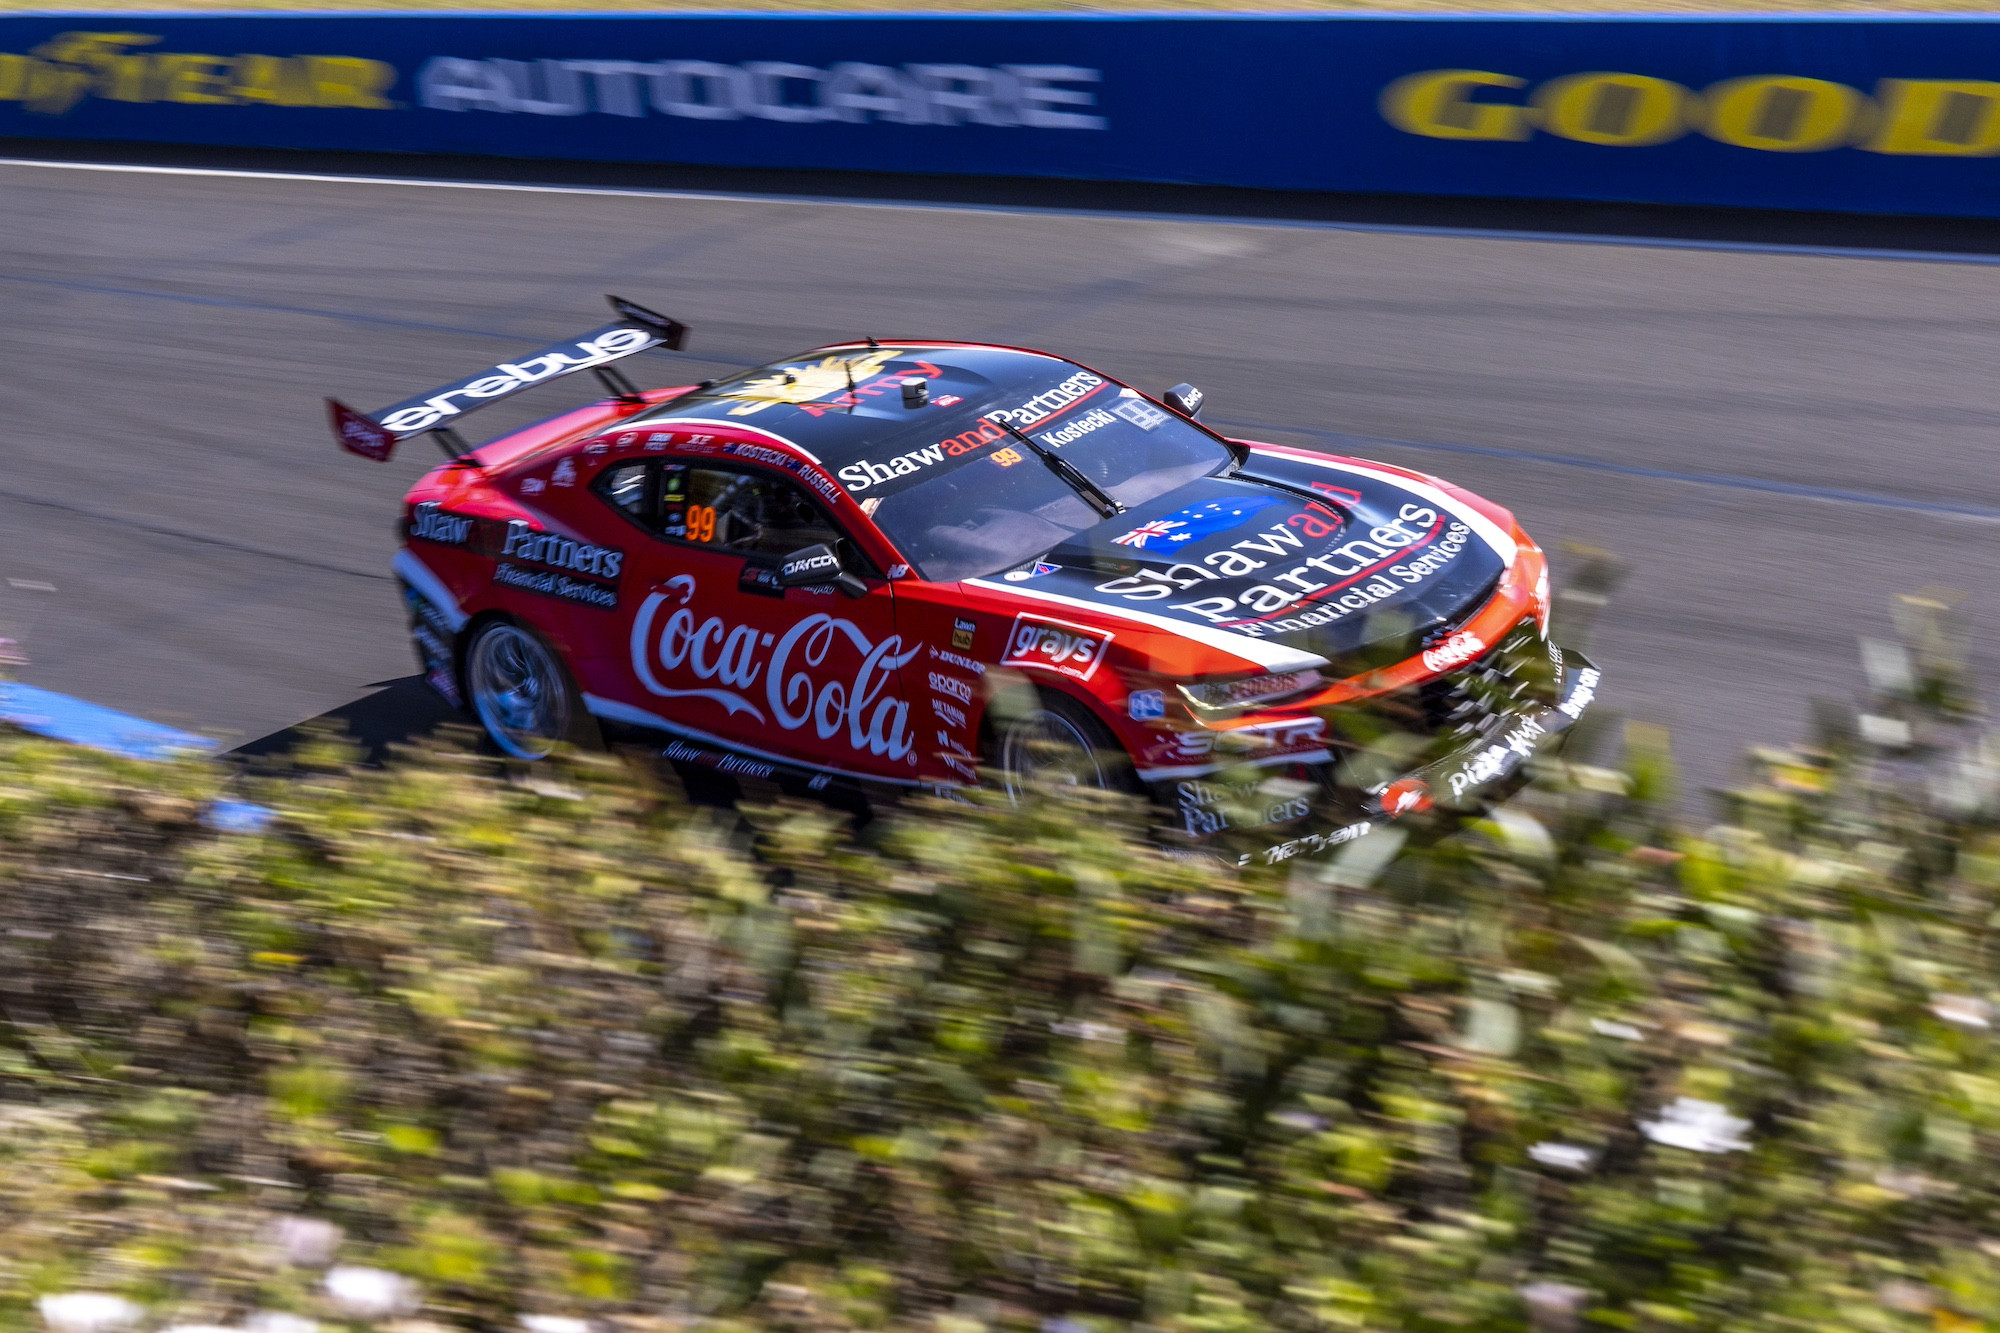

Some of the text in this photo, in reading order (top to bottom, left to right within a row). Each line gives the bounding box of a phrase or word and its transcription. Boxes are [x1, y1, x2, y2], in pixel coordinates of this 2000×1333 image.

[415, 57, 1108, 130] AUTOCARE
[379, 328, 650, 431] erebus
[797, 360, 944, 418] Army
[837, 370, 1104, 492] Shaw and Partners
[990, 447, 1022, 467] 99
[1040, 408, 1118, 449] Kostecki
[733, 442, 842, 505] KOSTECKI RUSSELL
[410, 501, 624, 579] Shaw Partners
[685, 504, 716, 543] 99
[1094, 523, 1310, 601] Shaw
[1167, 502, 1440, 625] Partners
[1230, 520, 1472, 639] Financial Services
[954, 617, 976, 633] Lawn
[1012, 625, 1097, 663] grays
[928, 671, 973, 701] sparco
[939, 650, 986, 675] DUNLOP
[1180, 795, 1312, 838] Parers
